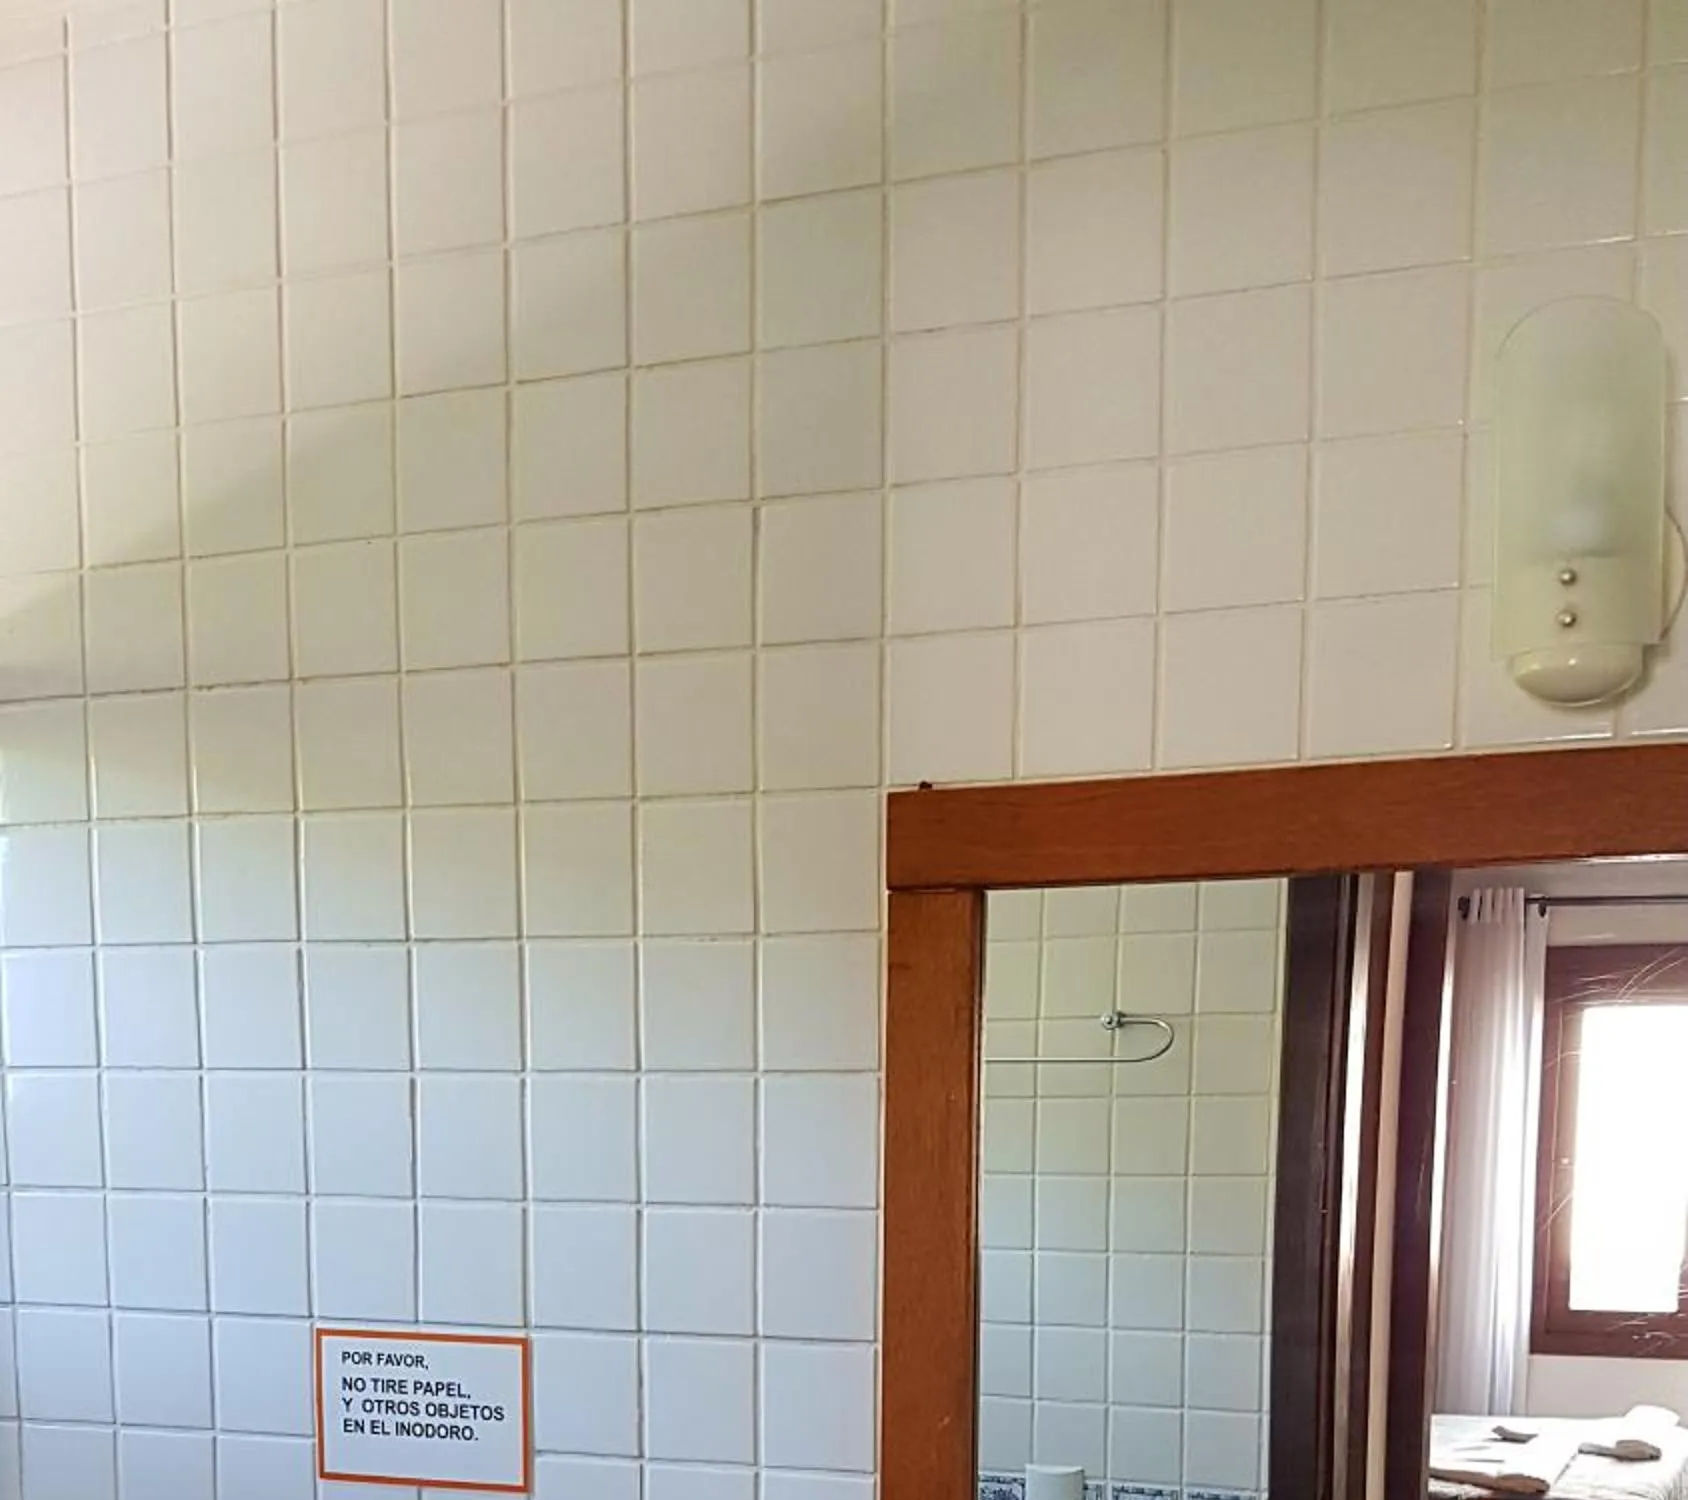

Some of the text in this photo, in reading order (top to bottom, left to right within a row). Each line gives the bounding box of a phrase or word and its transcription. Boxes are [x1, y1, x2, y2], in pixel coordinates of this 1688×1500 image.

[341, 1351, 429, 1369] POR FAVOR,
[341, 1377, 366, 1392] NO
[371, 1378, 408, 1395] TIRE
[342, 1398, 505, 1421] Y OTROS OBJETOS
[343, 1418, 479, 1441] EN EL INODORO.
